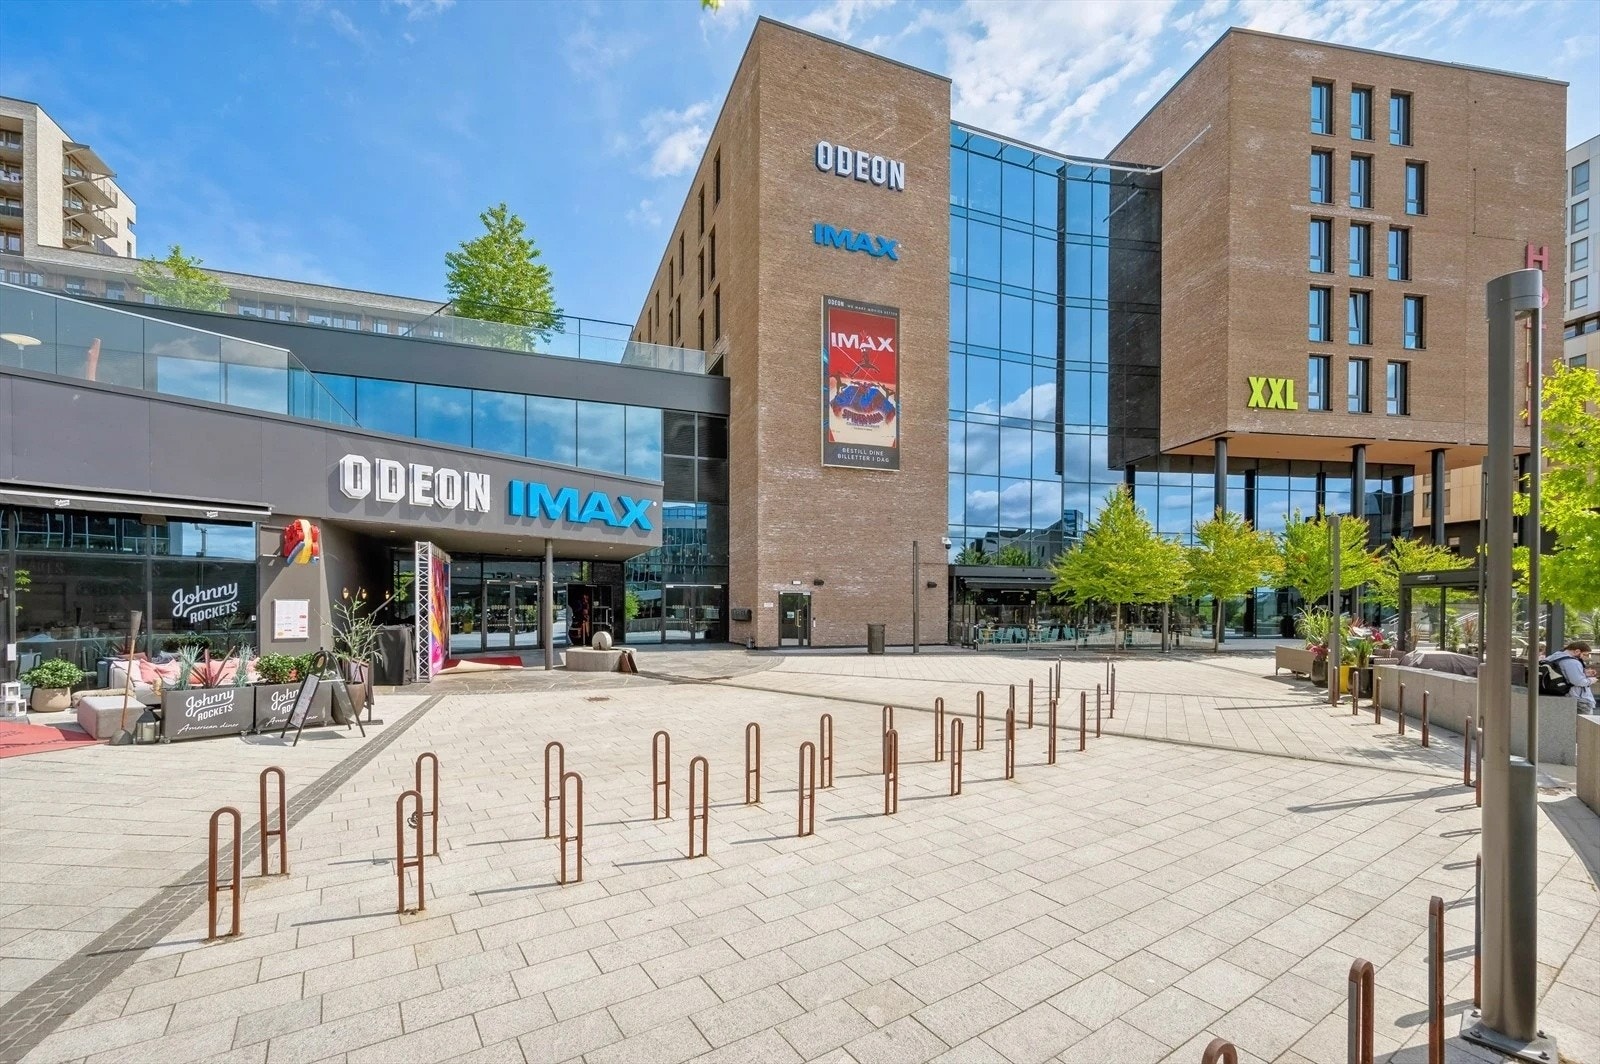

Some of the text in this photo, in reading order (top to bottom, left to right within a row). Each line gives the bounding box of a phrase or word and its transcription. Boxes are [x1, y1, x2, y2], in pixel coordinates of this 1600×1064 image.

[816, 140, 905, 191] ODEON
[814, 222, 899, 261] IMAX
[827, 298, 845, 307] ODEON
[831, 332, 894, 352] IMAX
[1247, 376, 1299, 410] XXL
[837, 453, 870, 461] BILLETTER
[842, 447, 867, 455] BESTILL
[339, 453, 654, 531] ODEON IMAX
[172, 582, 238, 618] Johnny
[190, 602, 238, 624] ROCKETS
[185, 689, 235, 718] Johnny
[271, 688, 300, 711] John
[197, 704, 234, 722] ROCKETS
[177, 721, 239, 735] American diner
